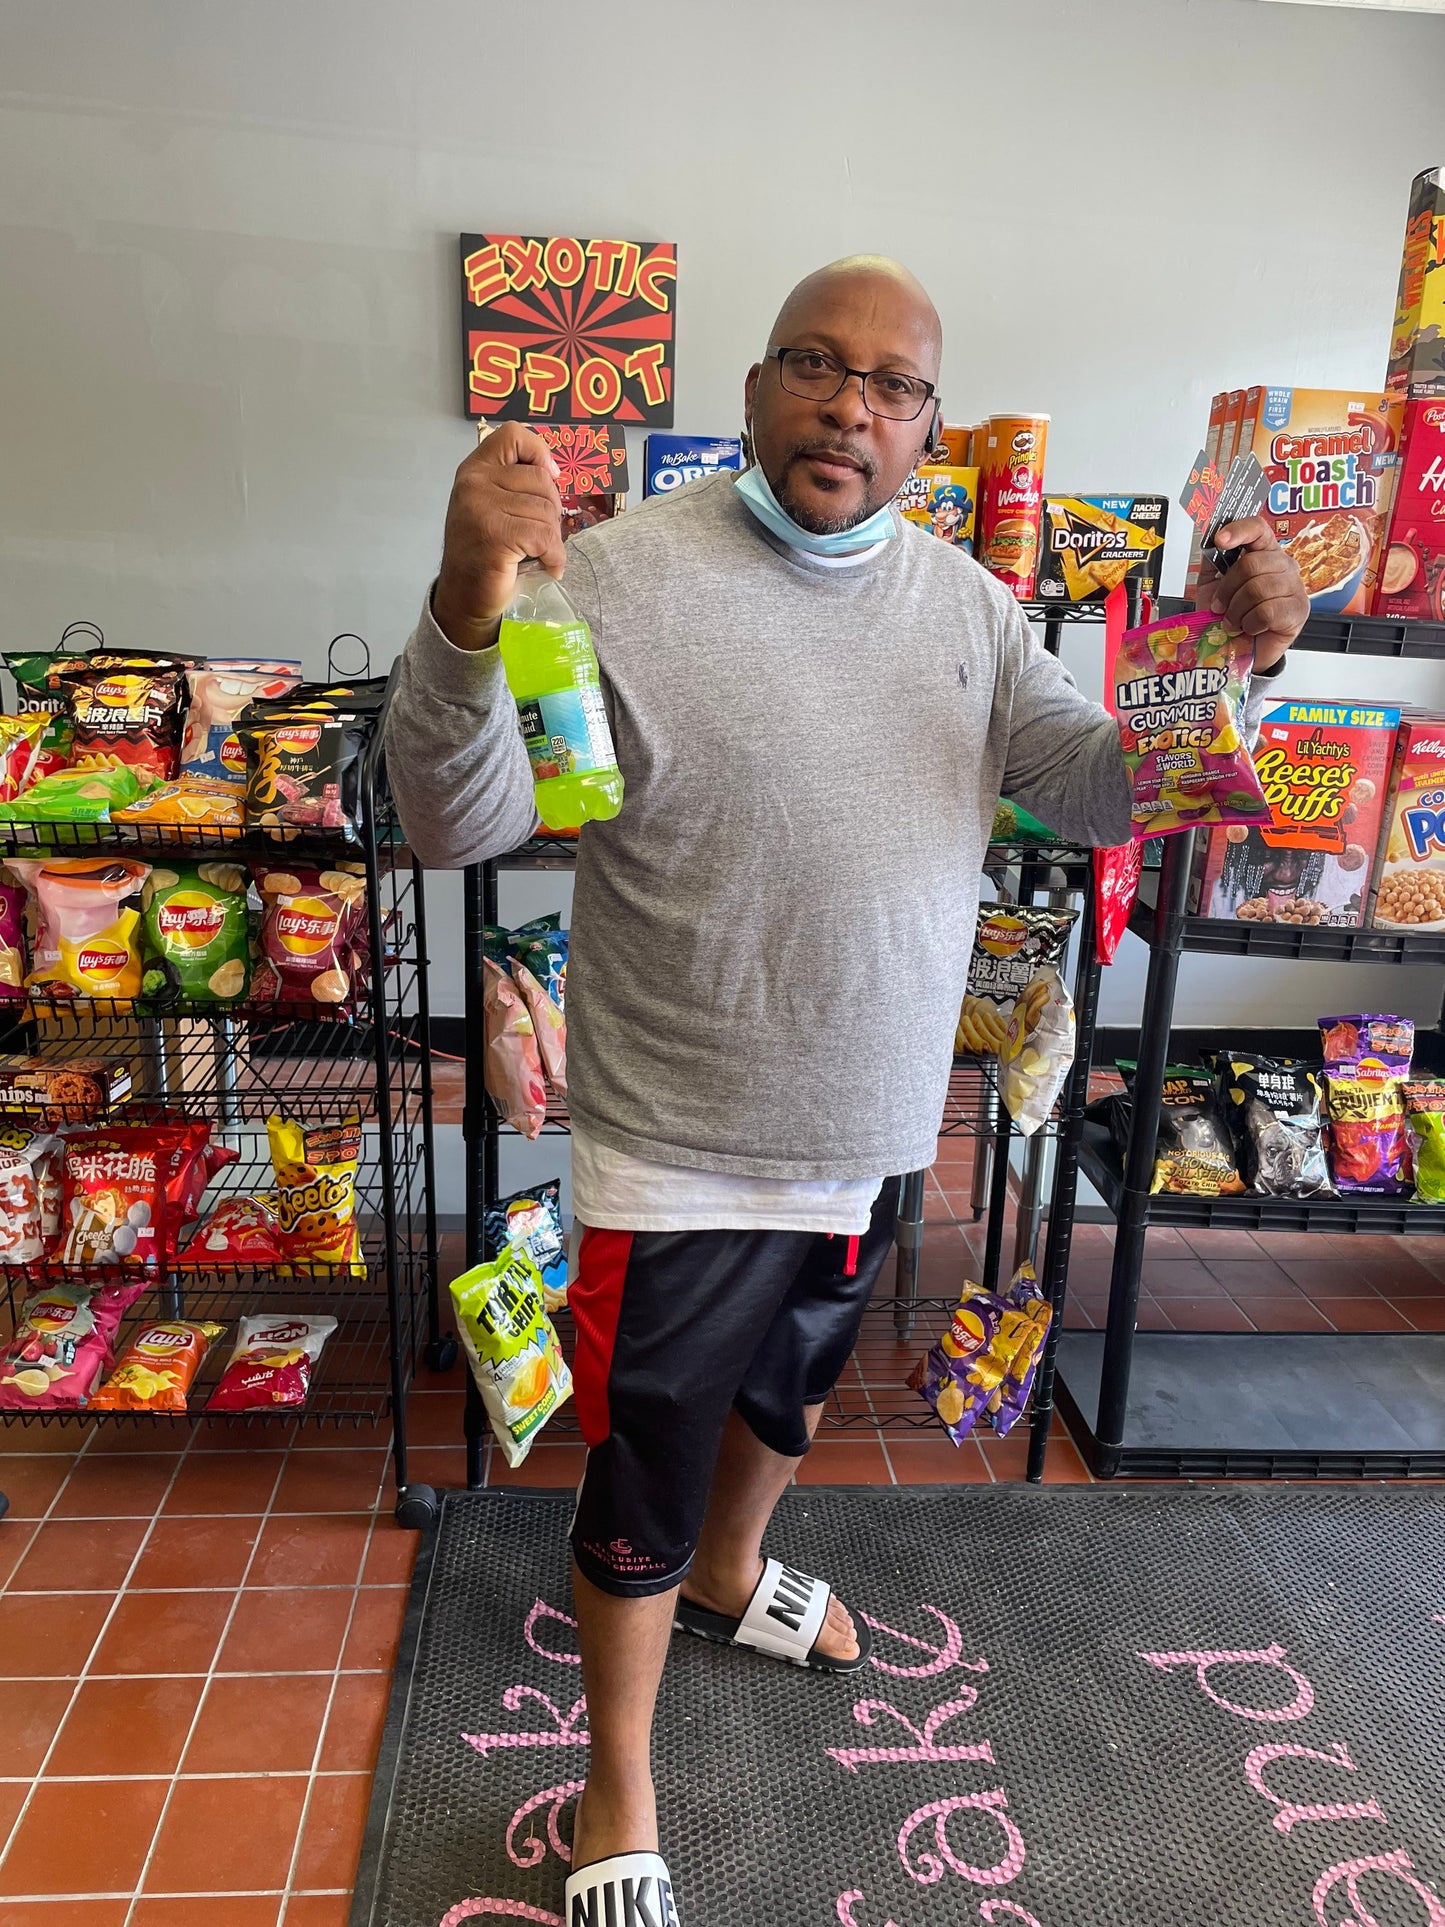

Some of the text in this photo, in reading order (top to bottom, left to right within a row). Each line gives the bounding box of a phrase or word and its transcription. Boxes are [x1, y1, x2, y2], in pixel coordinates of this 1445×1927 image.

[464, 237, 677, 312] EXOTIC
[469, 342, 664, 415] SPOT
[541, 427, 610, 454] XOTIC
[1273, 427, 1371, 460] Caramel
[1009, 449, 1038, 469] Pringles
[1288, 454, 1357, 485] Toast
[1375, 455, 1396, 467] NEW
[556, 464, 610, 493] POT
[1271, 473, 1373, 512] Crunch
[1102, 500, 1130, 509] NEW
[1133, 504, 1161, 512] NACHO
[1130, 511, 1161, 520] CHEESE
[1054, 529, 1127, 550] Doritos
[1130, 702, 1216, 732] GUMMIES
[1289, 706, 1385, 727] FAMILY SIZE
[1156, 752, 1192, 764] FLAVORS
[1297, 740, 1350, 760] Lil Yachty's
[1162, 760, 1196, 772] WORLD
[1256, 748, 1356, 788] Reese's
[1263, 783, 1344, 822] Puffs
[278, 915, 307, 934] Lay's
[981, 926, 1005, 940] Lay's
[80, 954, 104, 968] Lay's
[1356, 1067, 1390, 1078] Sabritas
[76, 1230, 111, 1244] Cheetos
[494, 1372, 502, 1382] 4
[511, 1408, 539, 1436] SWEET
[537, 1387, 555, 1412] CORN
[766, 1564, 815, 1632] NIK
[572, 1876, 677, 1927] NIKE
